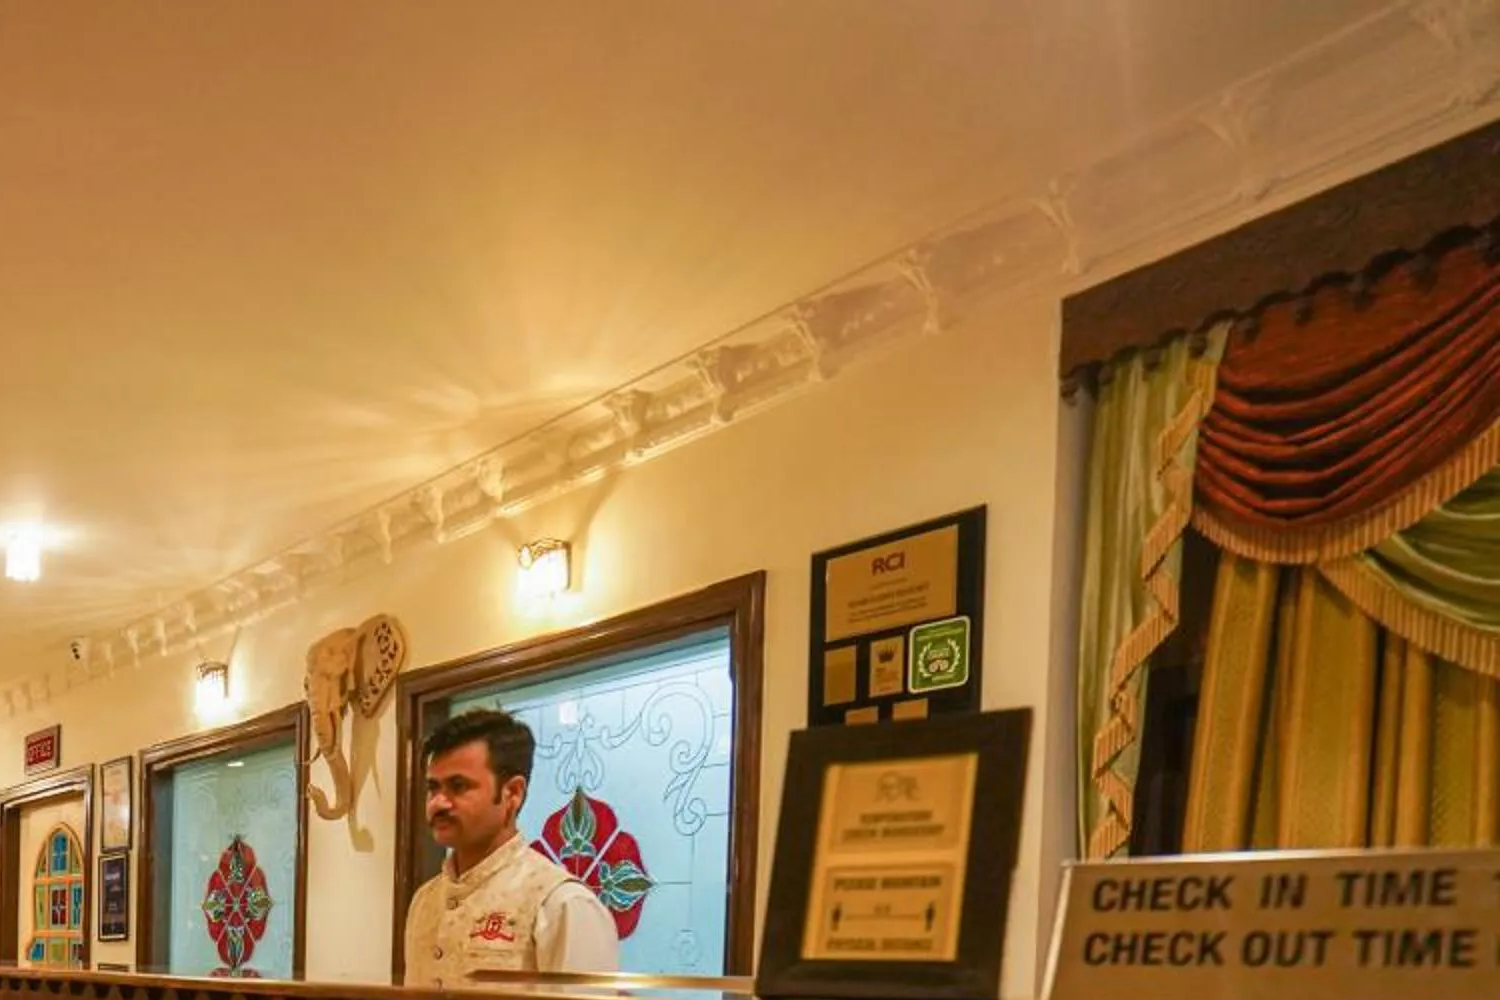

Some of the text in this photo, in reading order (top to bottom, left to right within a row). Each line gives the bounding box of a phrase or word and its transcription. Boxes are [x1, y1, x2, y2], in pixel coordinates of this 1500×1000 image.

[871, 552, 905, 576] RCI
[1092, 868, 1459, 913] CHECK IN TIME
[1082, 929, 1228, 967] CHECK
[1240, 928, 1337, 967] OUT
[1353, 928, 1479, 968] TIME
